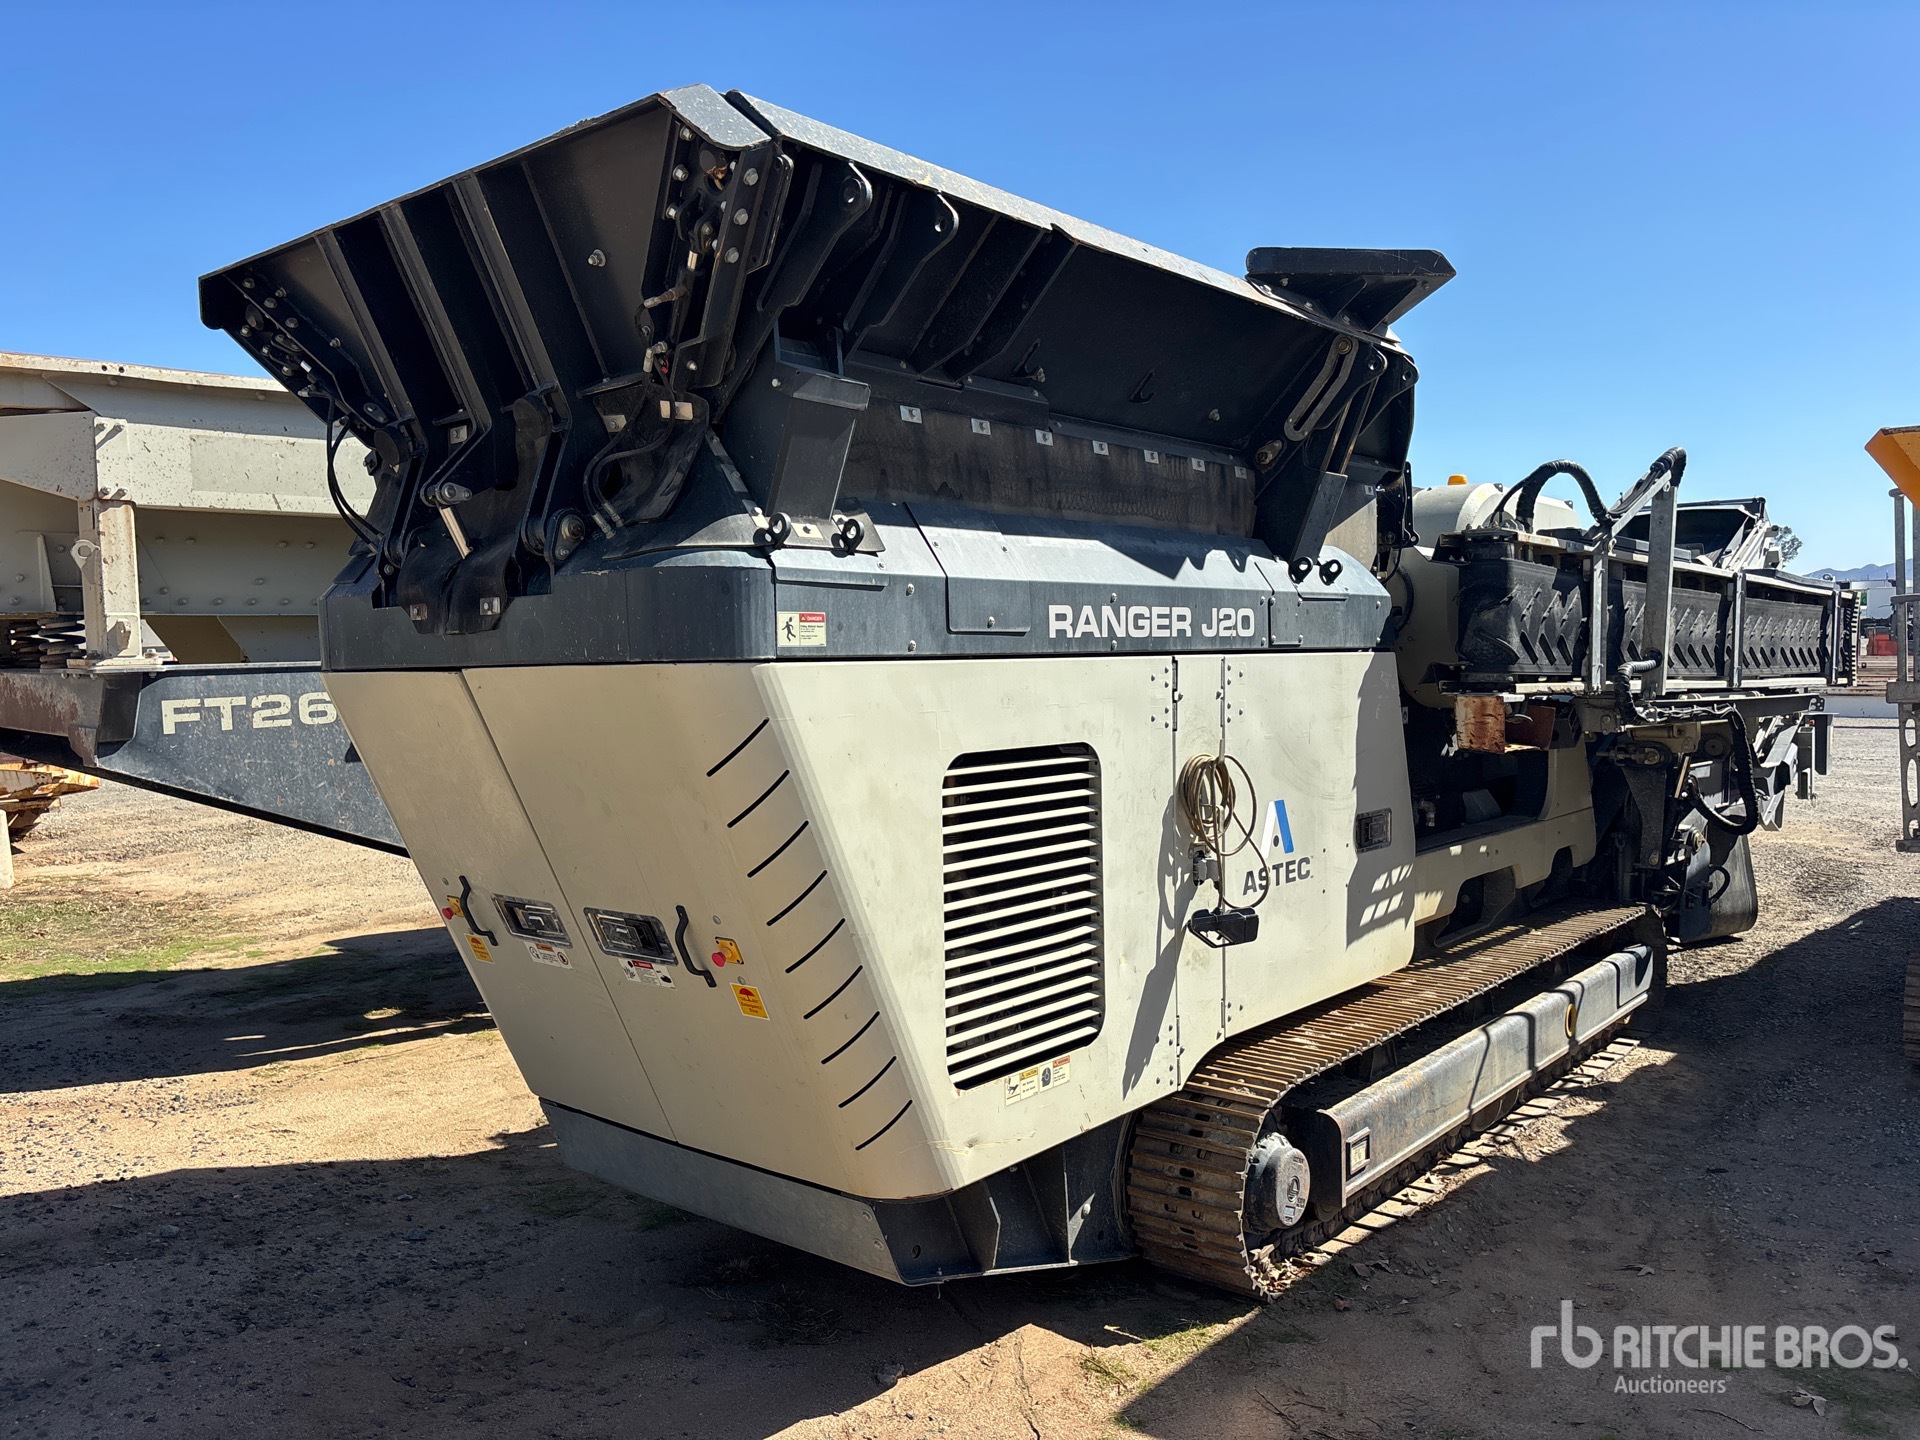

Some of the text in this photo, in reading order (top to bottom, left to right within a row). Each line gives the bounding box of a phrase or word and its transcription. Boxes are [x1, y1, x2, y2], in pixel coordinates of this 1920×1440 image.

[1048, 604, 1255, 638] RANGER J20
[161, 692, 338, 735] FT26
[1242, 856, 1311, 896] ASTEC
